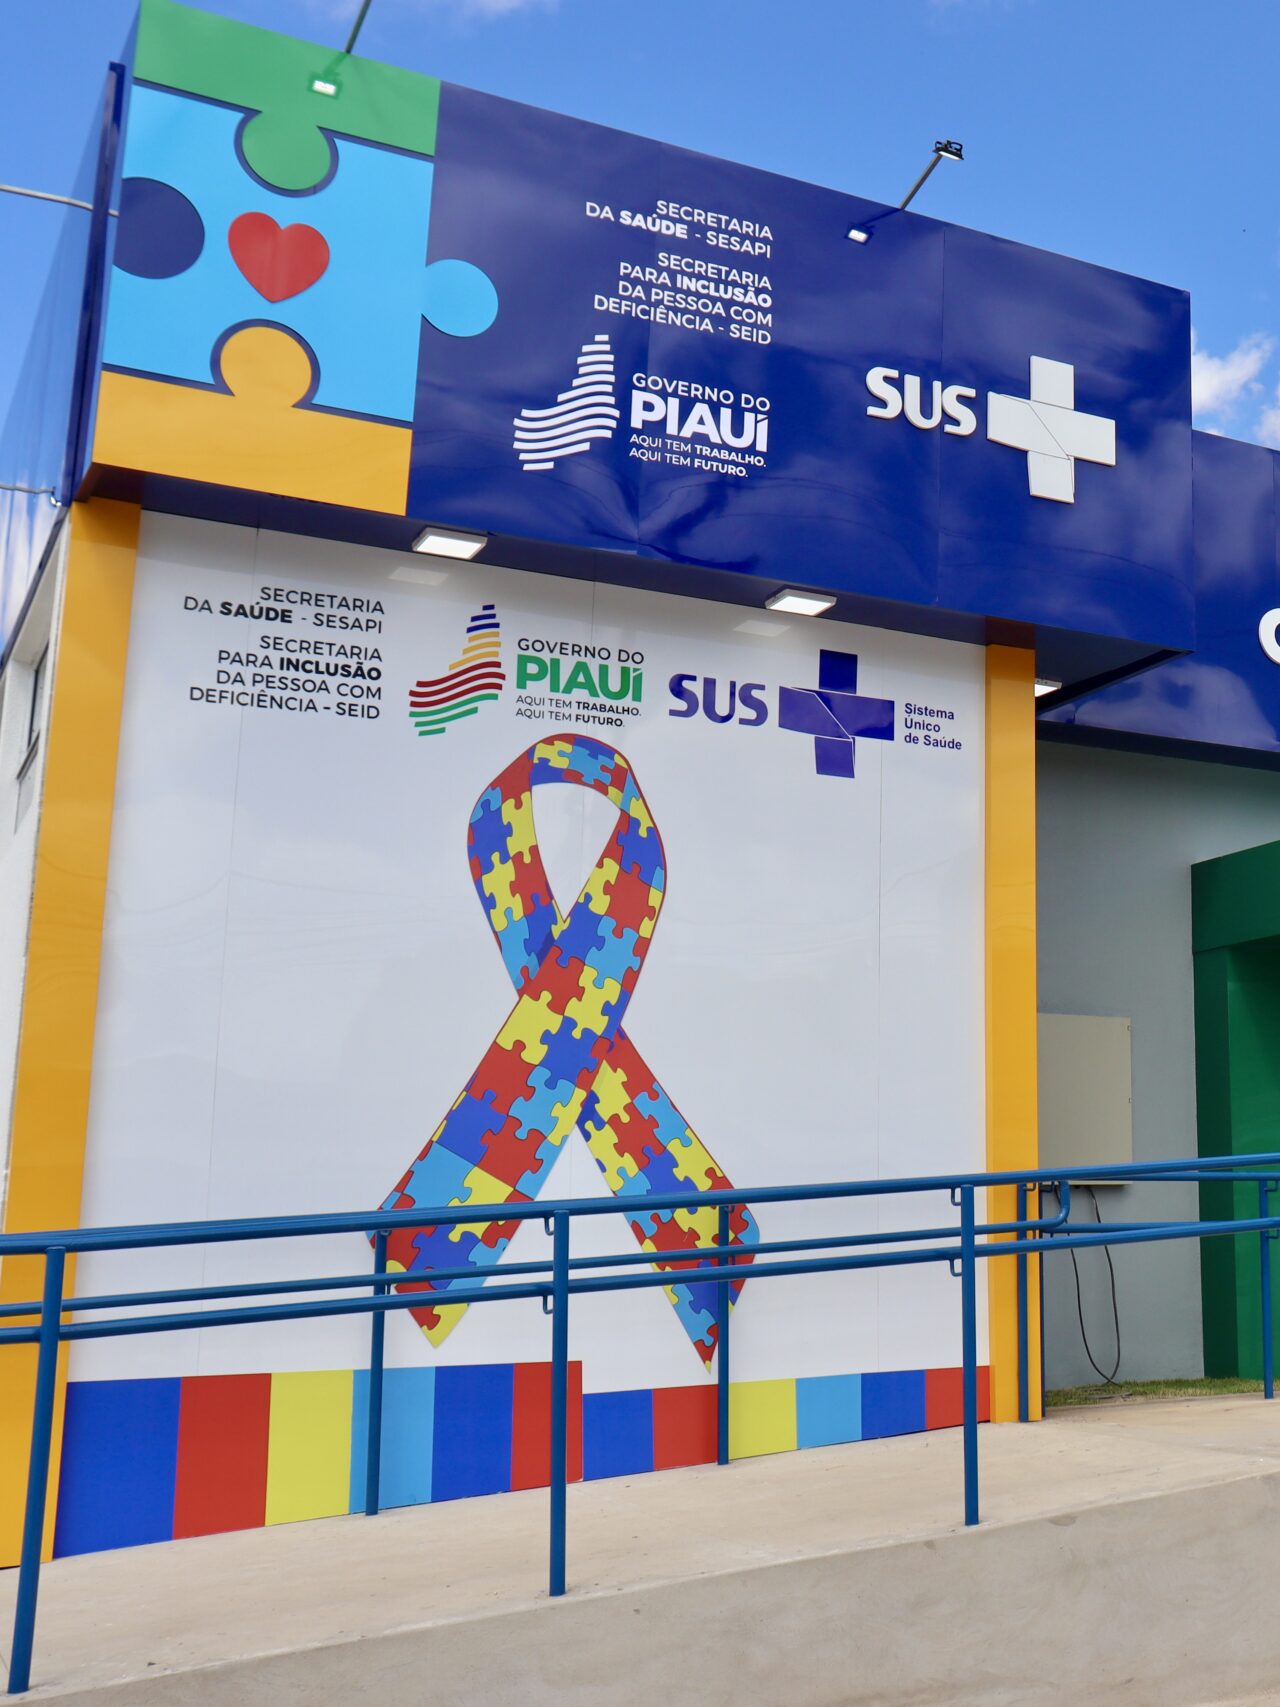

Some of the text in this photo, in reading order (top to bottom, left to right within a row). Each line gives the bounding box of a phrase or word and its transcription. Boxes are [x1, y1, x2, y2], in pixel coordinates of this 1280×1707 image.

[585, 201, 615, 221] DA
[619, 210, 688, 239] SAÚDE
[706, 230, 771, 258] SESAPI
[656, 200, 773, 240] SECRETARIA
[619, 261, 772, 308] PARA INCLUSÃO
[657, 252, 772, 290] SECRETARIA
[594, 294, 714, 333] DEFICIÊNCIA
[729, 324, 772, 345] SEID
[618, 280, 772, 327] DA PESSOA COM
[632, 372, 771, 412] GOVERNO DO
[865, 366, 977, 436] SUS
[630, 389, 769, 453] PIAUÍ
[629, 433, 767, 468] AQUI TEM TRABALHO.
[629, 447, 748, 478] AQUI TEM FUTURO.
[184, 596, 213, 614] DA
[219, 601, 293, 624] SAÚDE
[312, 613, 382, 634] SESAPI
[260, 587, 384, 615] SECRETARIA
[218, 650, 382, 681] PARA INCLUSÃO
[259, 635, 383, 662] SECRETARIA
[517, 638, 644, 664] GOVERNO DO
[216, 670, 382, 700] DA PESSOA COM
[516, 654, 643, 703] PIAUÍ
[189, 686, 319, 713] DEFICIÊNCIA
[335, 702, 380, 719] SEID
[516, 695, 642, 716] AQUI TEM TRABALHO.
[668, 673, 769, 727] SUS
[904, 703, 955, 720] Sistema
[515, 708, 625, 728] AQUI TEM FUTURO.
[904, 715, 941, 733] Único
[904, 732, 962, 750] de Saúde
